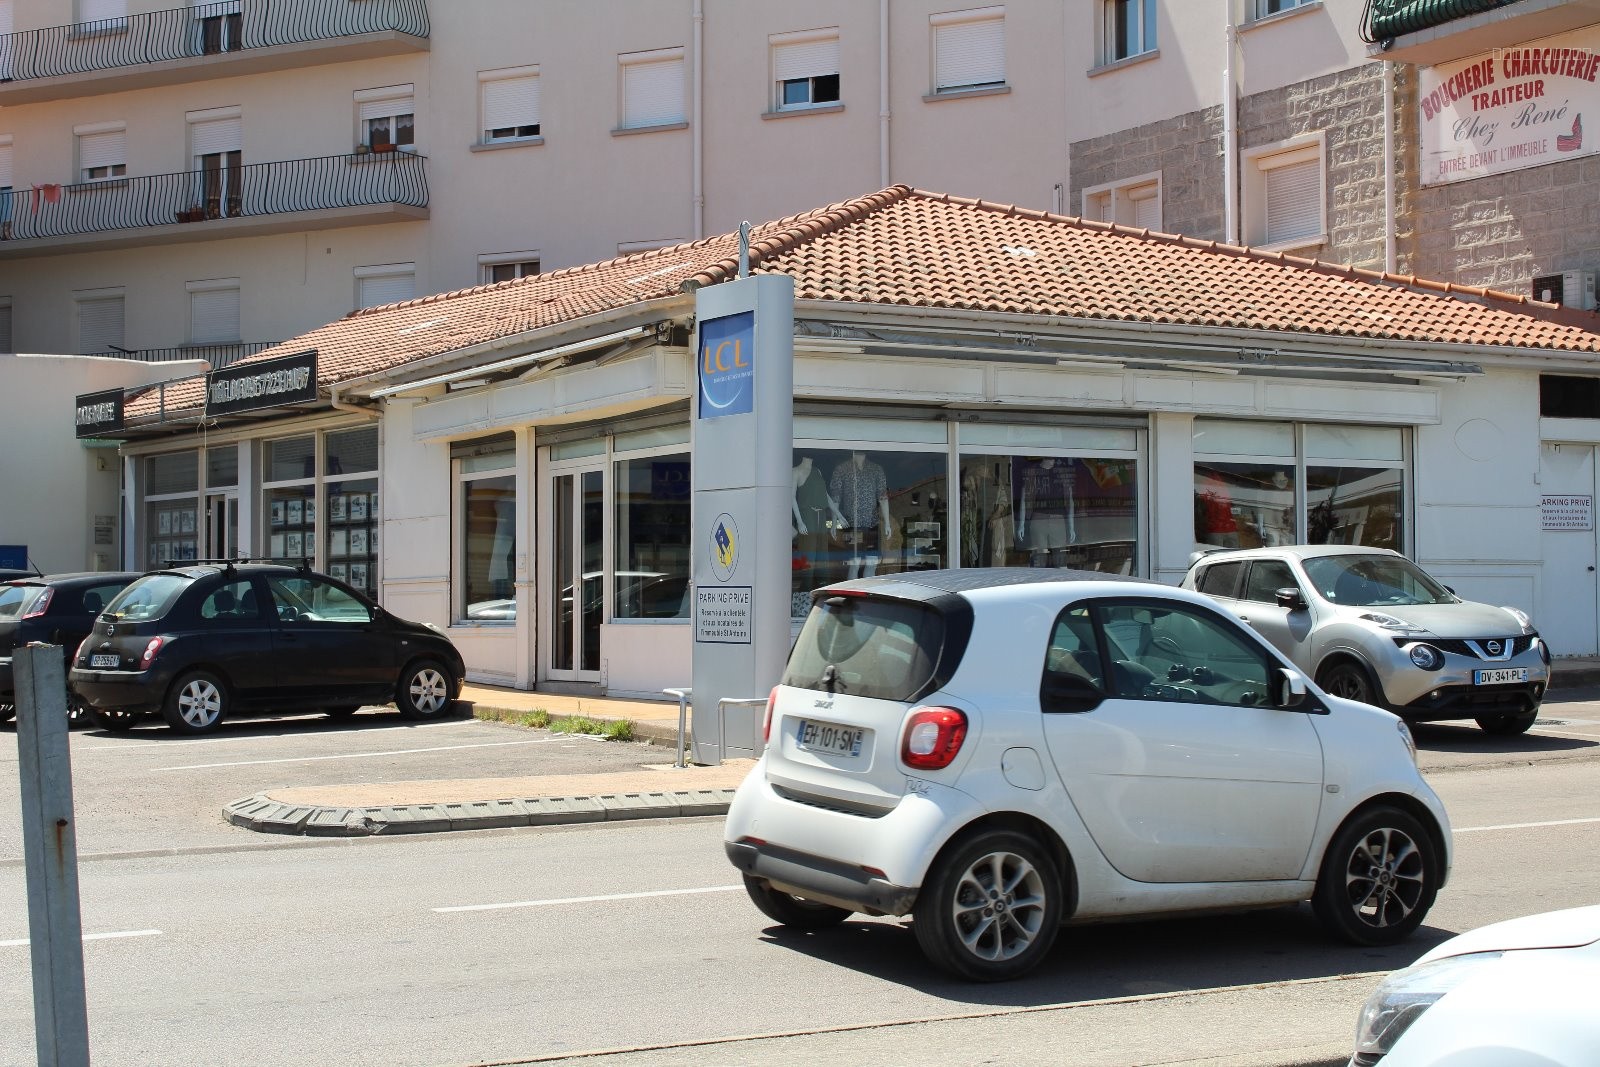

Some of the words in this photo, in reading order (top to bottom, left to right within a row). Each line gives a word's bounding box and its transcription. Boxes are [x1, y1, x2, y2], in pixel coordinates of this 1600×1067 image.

[1421, 57, 1495, 122] BOUCHERIE
[1502, 48, 1600, 83] CHARCUTERIE
[1471, 79, 1545, 112] TRAITEUR
[1452, 115, 1500, 147] Chez
[1510, 99, 1569, 130] René
[1469, 149, 1498, 168] DEVANT
[1500, 138, 1548, 161] L'IMMEUBLE
[704, 338, 749, 375] LCL
[1541, 498, 1569, 506] ARKING
[1481, 670, 1522, 682] DV-341-PL
[803, 723, 856, 751] EH-101-SN
